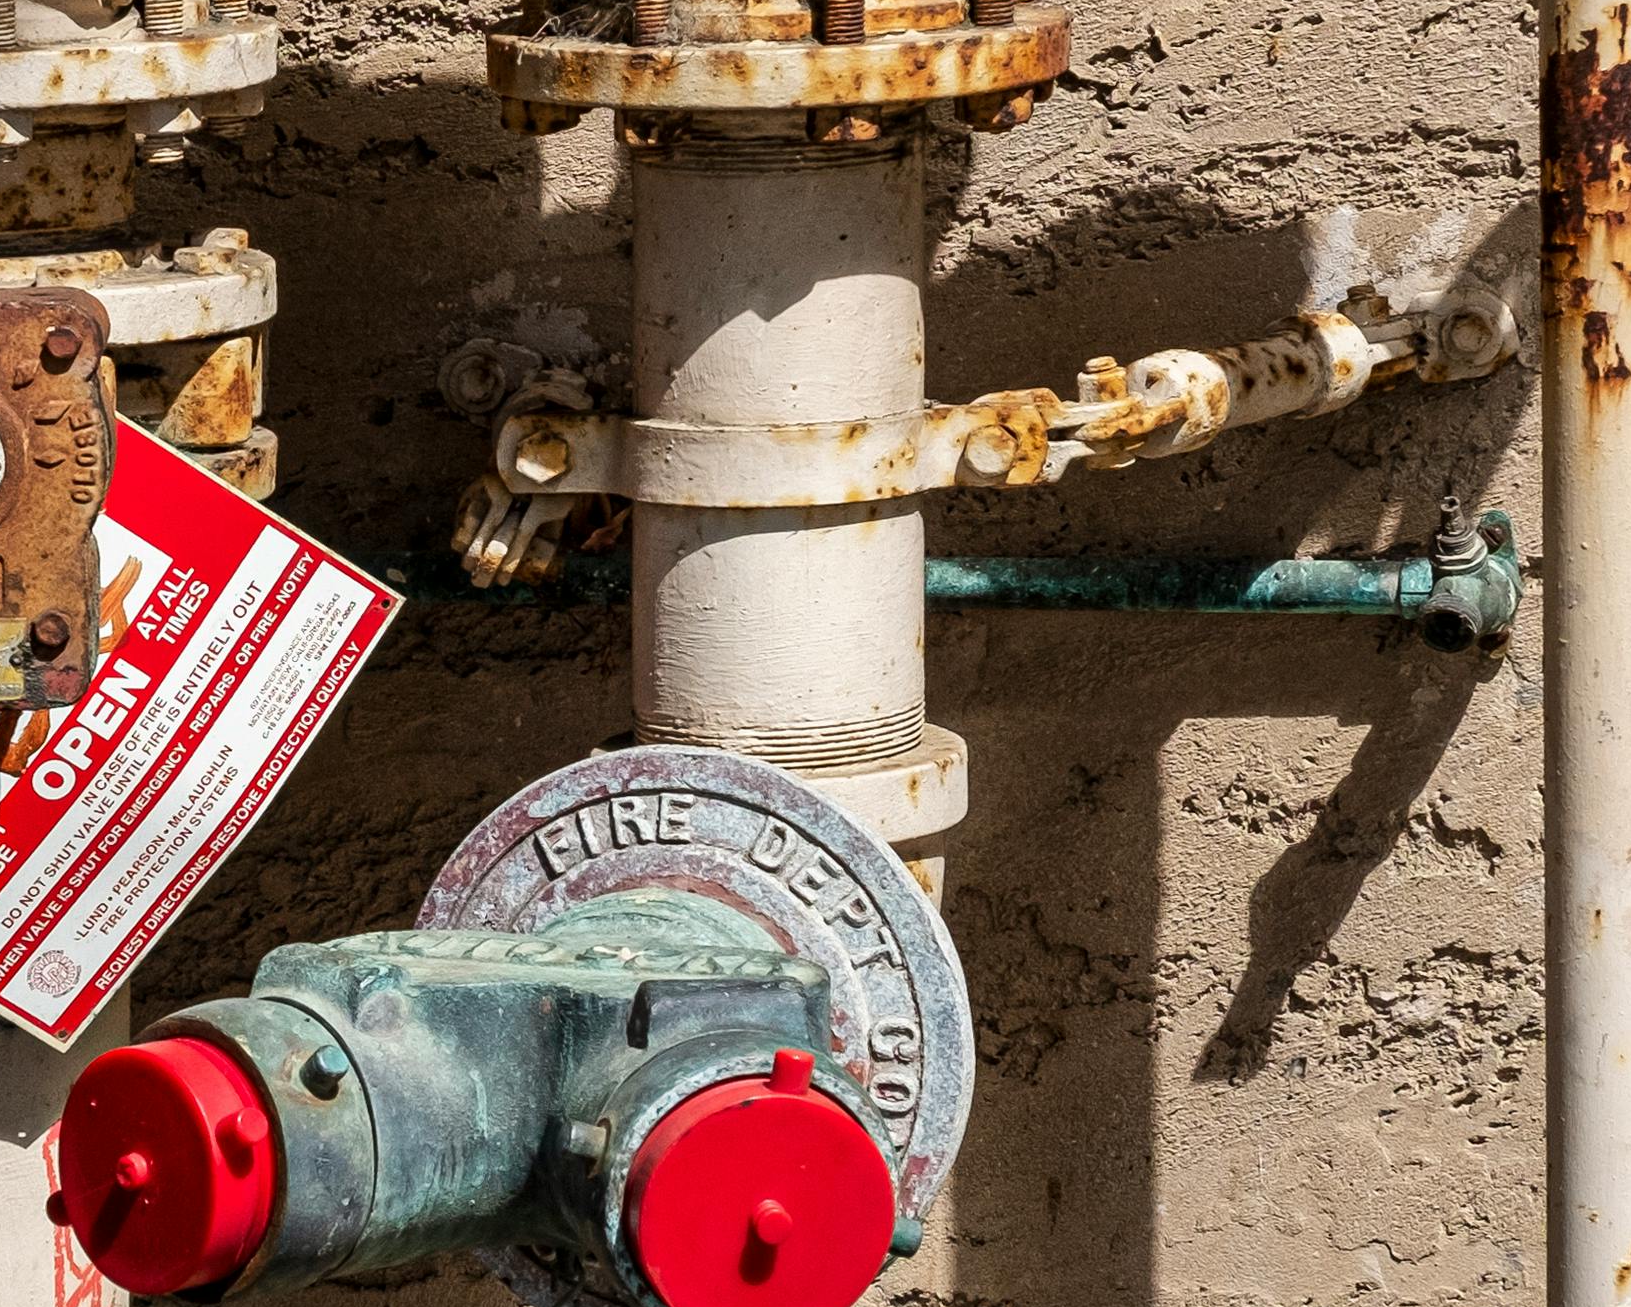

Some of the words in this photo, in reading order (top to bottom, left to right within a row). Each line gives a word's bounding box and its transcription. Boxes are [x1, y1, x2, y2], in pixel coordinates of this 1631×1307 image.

[131, 602, 167, 640] AT
[152, 558, 197, 610] ALL
[152, 576, 215, 650] TIMES
[229, 579, 265, 620] OUT
[171, 620, 241, 706] ENTIRELY
[246, 685, 280, 728] MOUNTAIN
[288, 616, 327, 663] CALIFORNIA
[256, 634, 304, 695] INDEPENDENCE
[21, 896, 63, 945] VALVE
[56, 885, 73, 903] IS
[67, 849, 103, 890] SHUT
[96, 821, 126, 855] FOR
[120, 741, 189, 827] EMERGENCY
[186, 670, 239, 734] REPAIRS
[233, 640, 257, 667] OR
[247, 608, 279, 644] FIRE
[273, 550, 318, 605] NOTIFY
[24, 655, 155, 809] OPEN
[80, 788, 99, 809] IN
[93, 751, 129, 793] CASE
[122, 729, 144, 754] OF
[138, 695, 169, 731] FIRE
[141, 721, 171, 756] FIRE
[164, 704, 182, 723] IS
[109, 753, 147, 797] UNTIL
[73, 793, 115, 844] VALVE
[76, 900, 109, 939] LUND
[111, 831, 166, 898] PEARSON
[166, 743, 236, 830] McLAUGHLIN
[94, 925, 150, 992] REQUEST
[253, 700, 325, 790] PROTECTION
[311, 639, 365, 704] QUICKLY
[99, 903, 128, 937] FIRE
[123, 823, 193, 909] PROTECTION
[187, 764, 240, 829] SYSTEMS
[18, 876, 47, 909] NOT
[43, 839, 78, 880] SHUT
[0, 905, 23, 930] DO
[531, 793, 696, 881] FIRE
[746, 812, 907, 974] DEPT
[867, 1016, 919, 1118] CO
